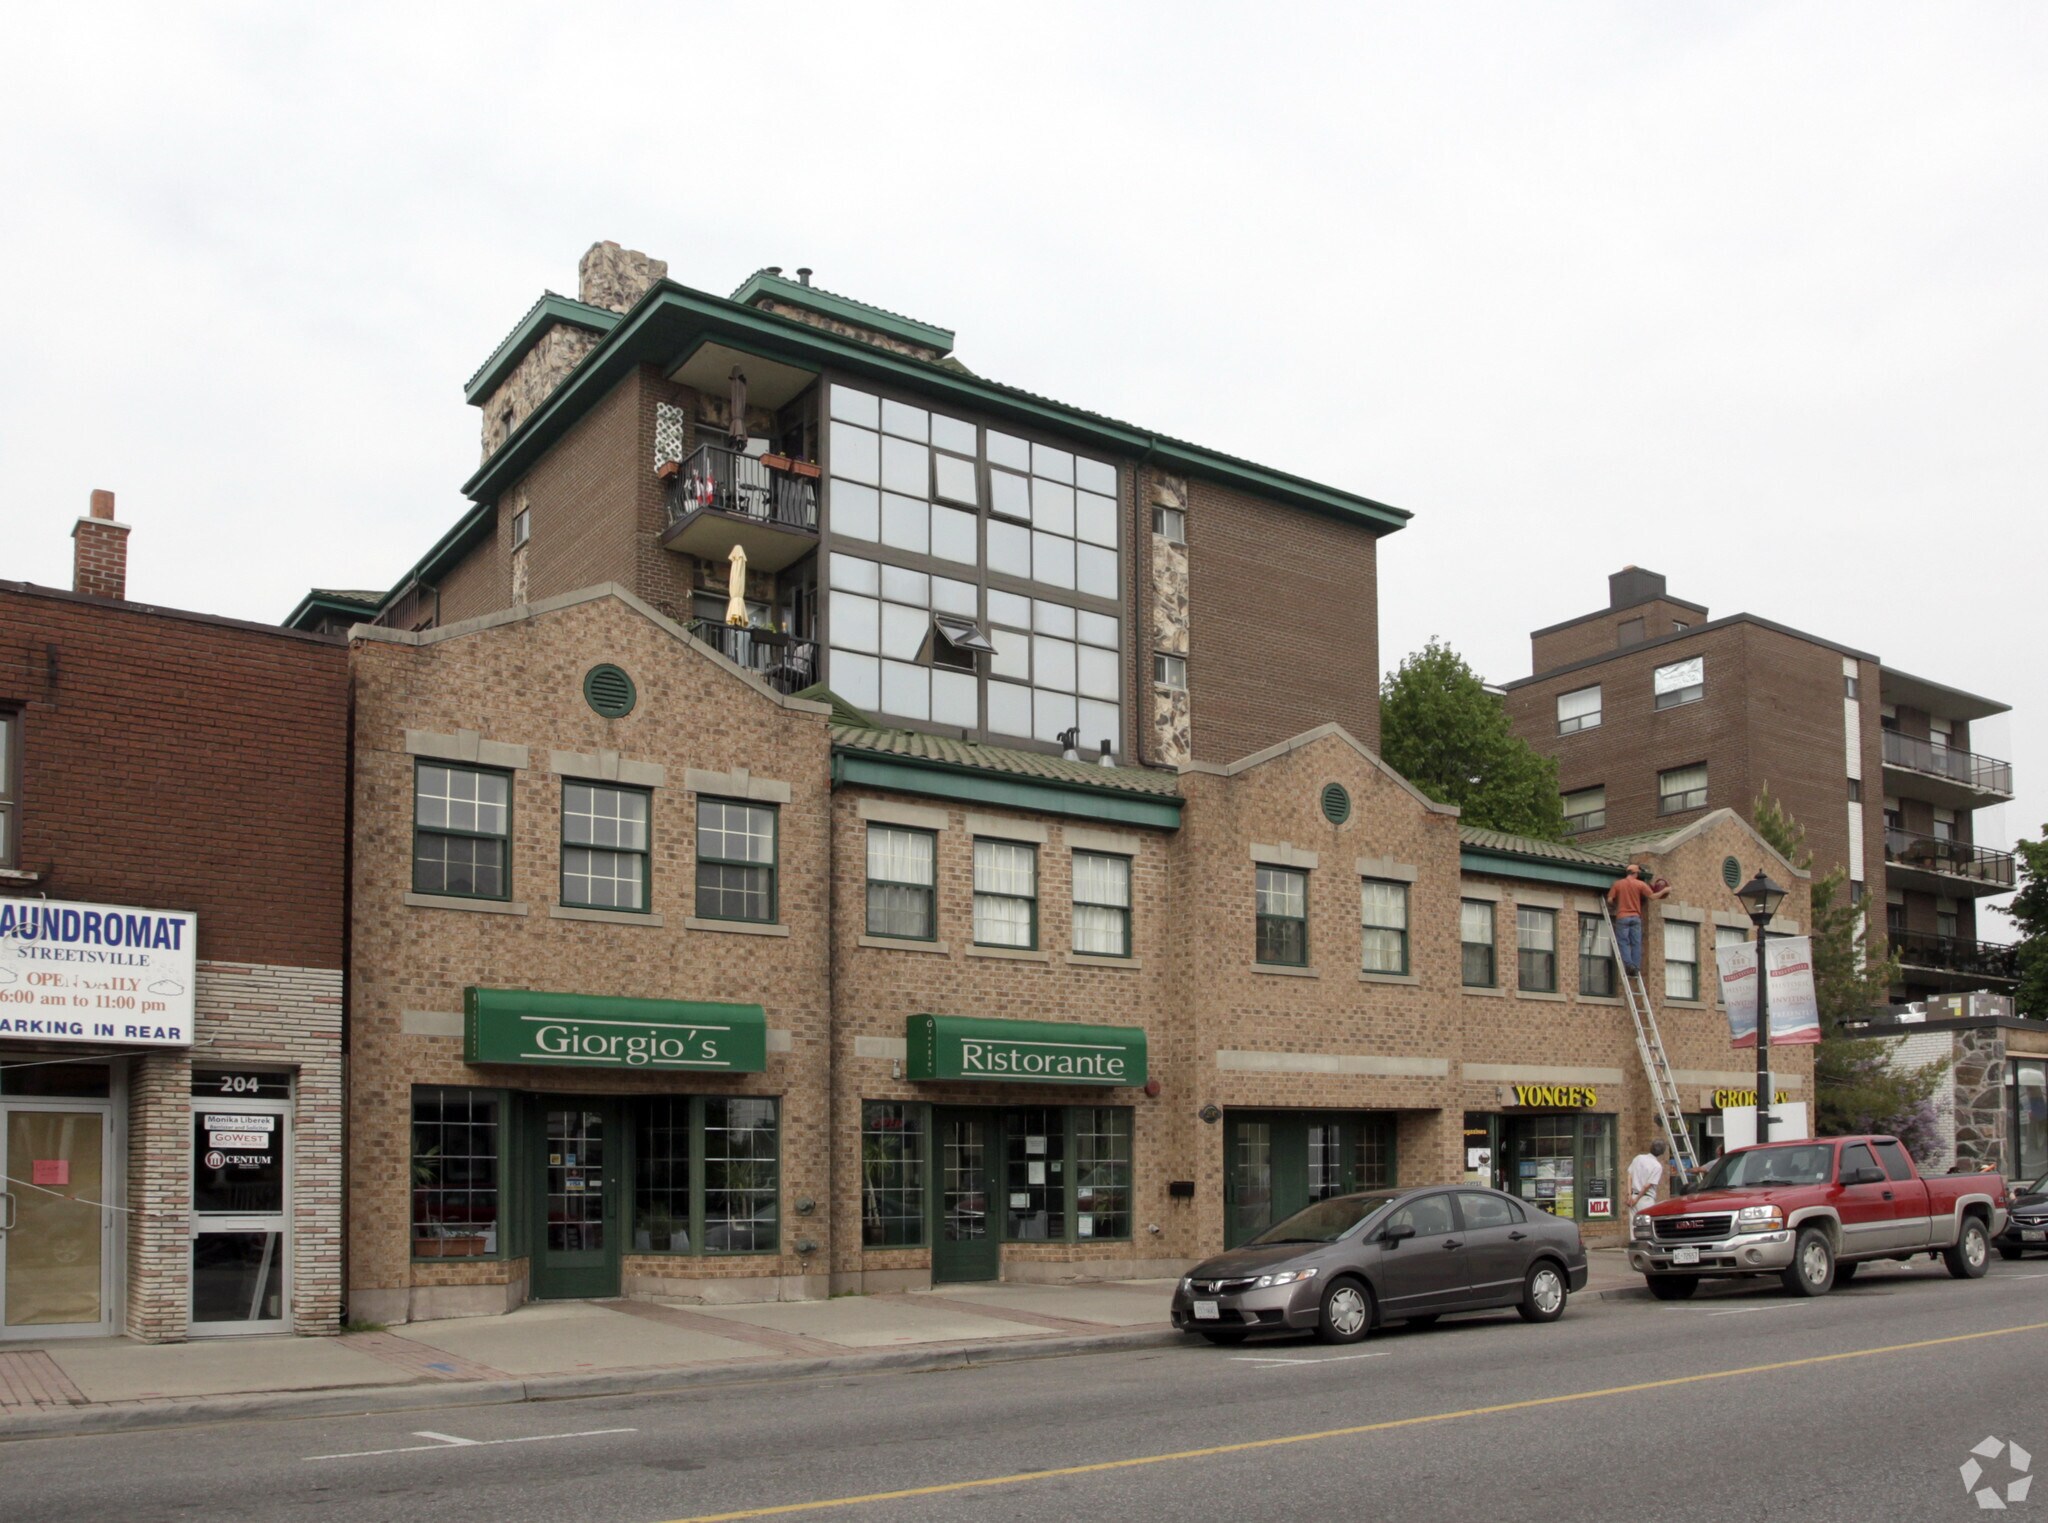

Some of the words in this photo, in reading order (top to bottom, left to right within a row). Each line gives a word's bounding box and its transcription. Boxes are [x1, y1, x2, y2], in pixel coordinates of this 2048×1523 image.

[17, 946, 150, 967] STREETSVILLE
[0, 989, 34, 1004] 6:00
[40, 995, 66, 1007] am
[72, 993, 89, 1007] to
[95, 995, 135, 1009] 11:00
[141, 1000, 166, 1014] pm
[1773, 995, 1812, 1004] INVITING
[94, 1023, 114, 1037] IN
[125, 1025, 181, 1040] REAR
[536, 1026, 717, 1065] Giorgio's
[963, 1044, 1125, 1075] Ristorante
[221, 1076, 259, 1093] 204
[1515, 1085, 1597, 1107] YONGE'S
[1715, 1089, 1788, 1109] GROCRY
[226, 1155, 272, 1164] CENTUM
[1590, 1201, 1609, 1213] MILK
